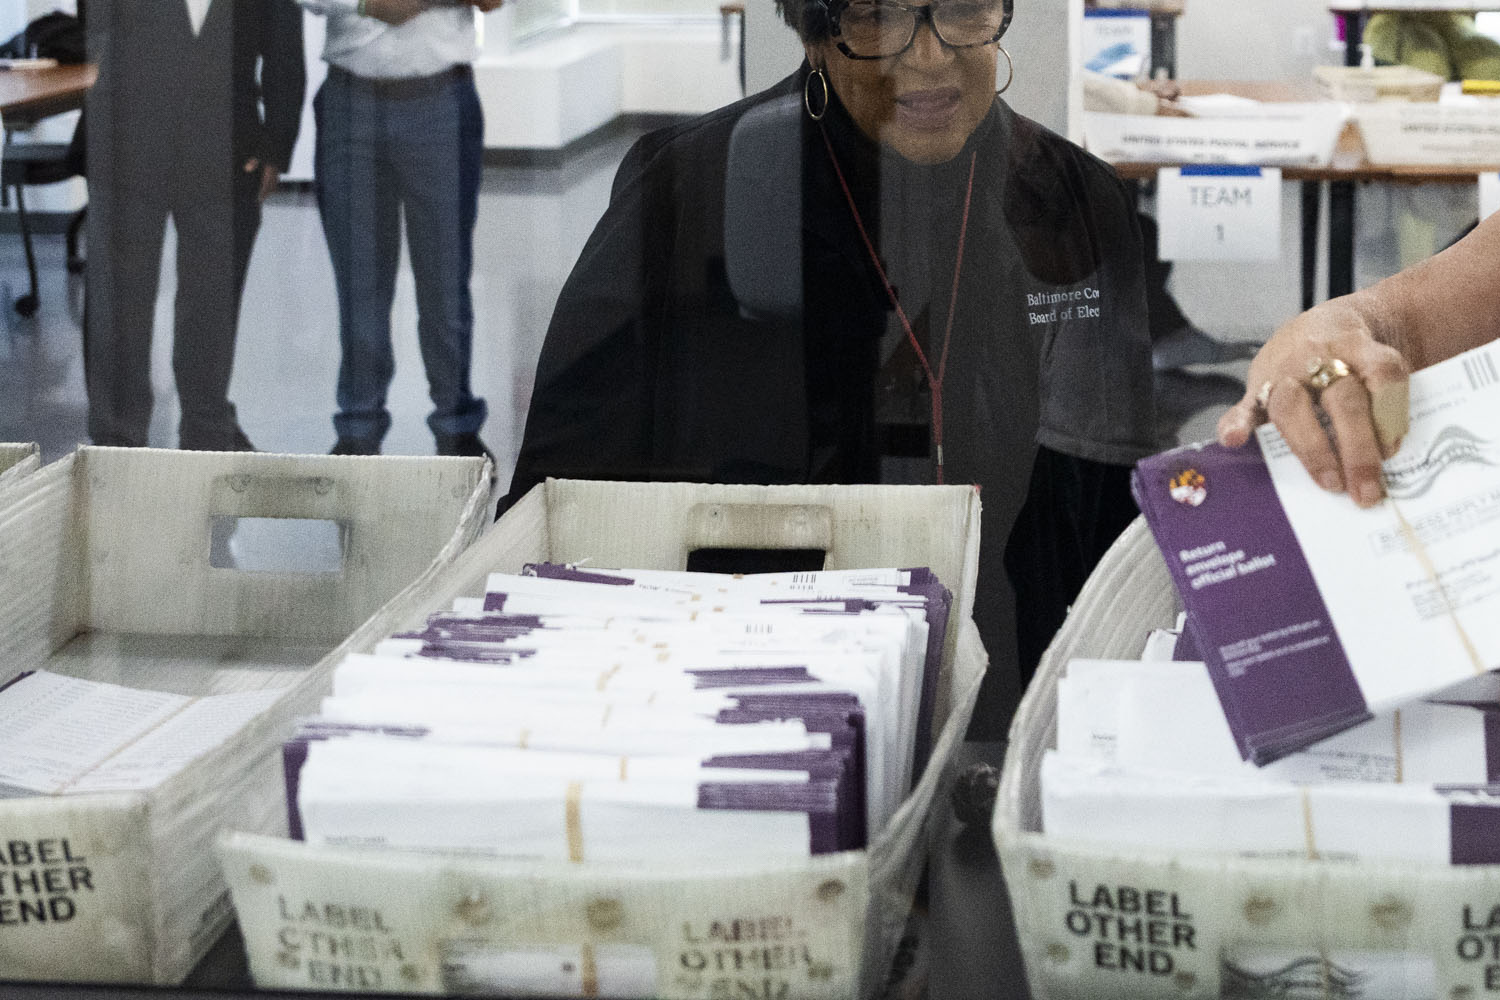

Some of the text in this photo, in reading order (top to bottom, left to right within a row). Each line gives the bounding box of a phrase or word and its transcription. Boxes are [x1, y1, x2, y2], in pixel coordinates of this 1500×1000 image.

[1189, 186, 1252, 208] TEAM
[1215, 223, 1225, 242] 1
[1027, 289, 1082, 306] Baltimore
[1029, 309, 1057, 325] Board
[1060, 306, 1073, 321] of
[1179, 541, 1227, 562] Return
[1185, 549, 1245, 577] envelope
[1190, 553, 1277, 591] official ballot
[0, 896, 77, 926] END
[1069, 879, 1192, 919] LABEL
[1066, 909, 1197, 950] OTHER
[1094, 940, 1174, 976] END
